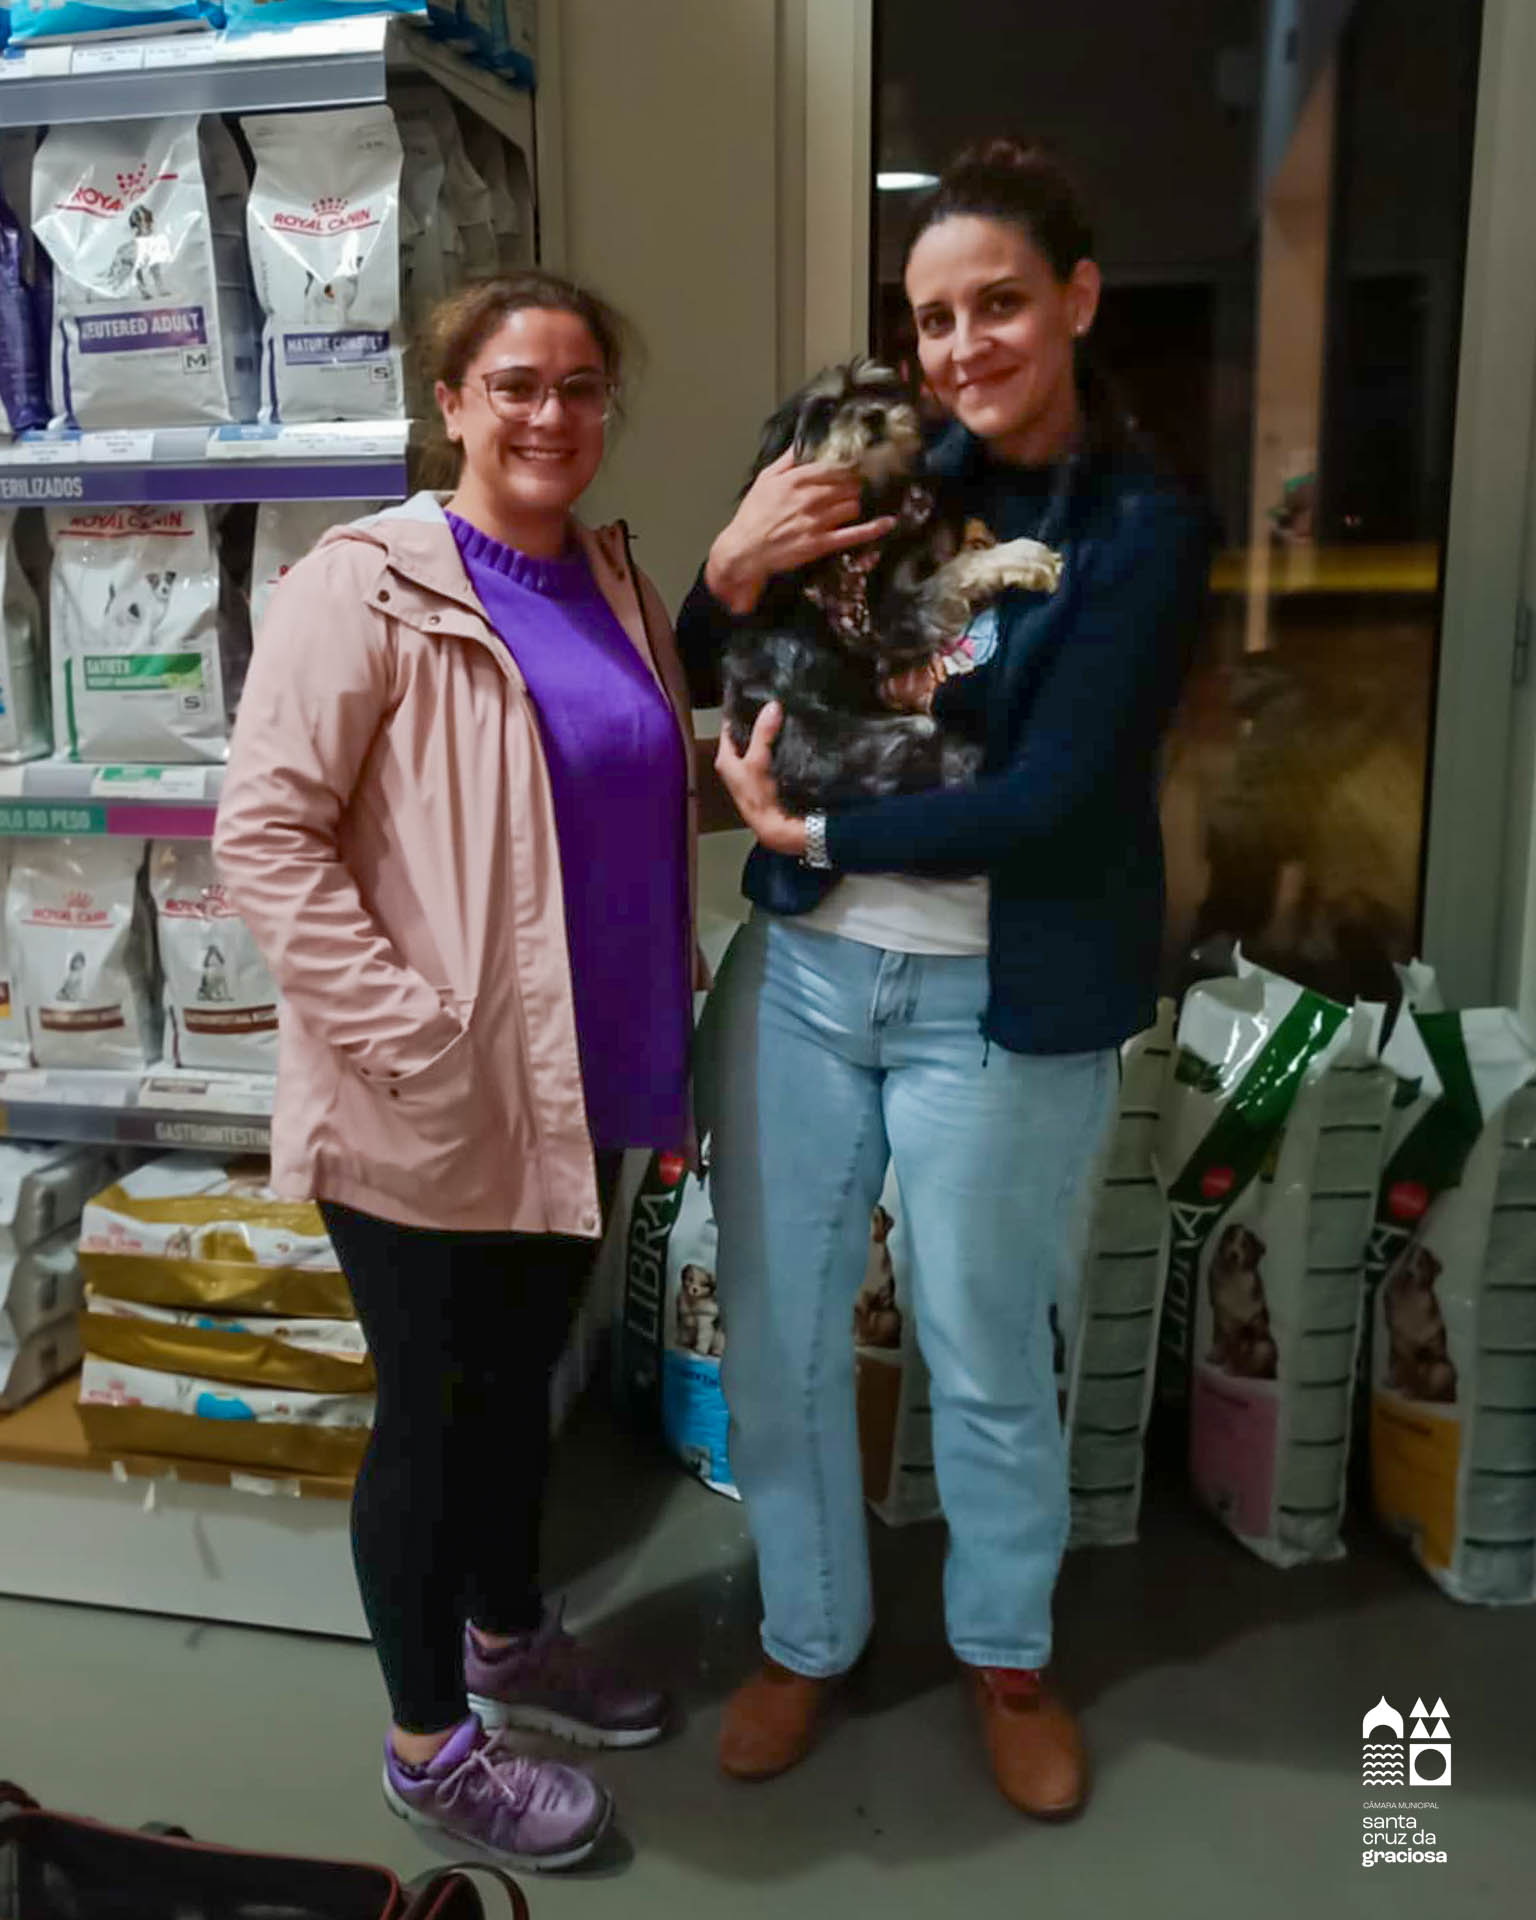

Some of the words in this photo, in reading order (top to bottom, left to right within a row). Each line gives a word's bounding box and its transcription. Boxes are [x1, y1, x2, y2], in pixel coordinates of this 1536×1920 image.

[273, 212, 323, 231] ROYAL
[151, 313, 199, 333] ADULT
[186, 353, 207, 368] M
[183, 695, 201, 710] S
